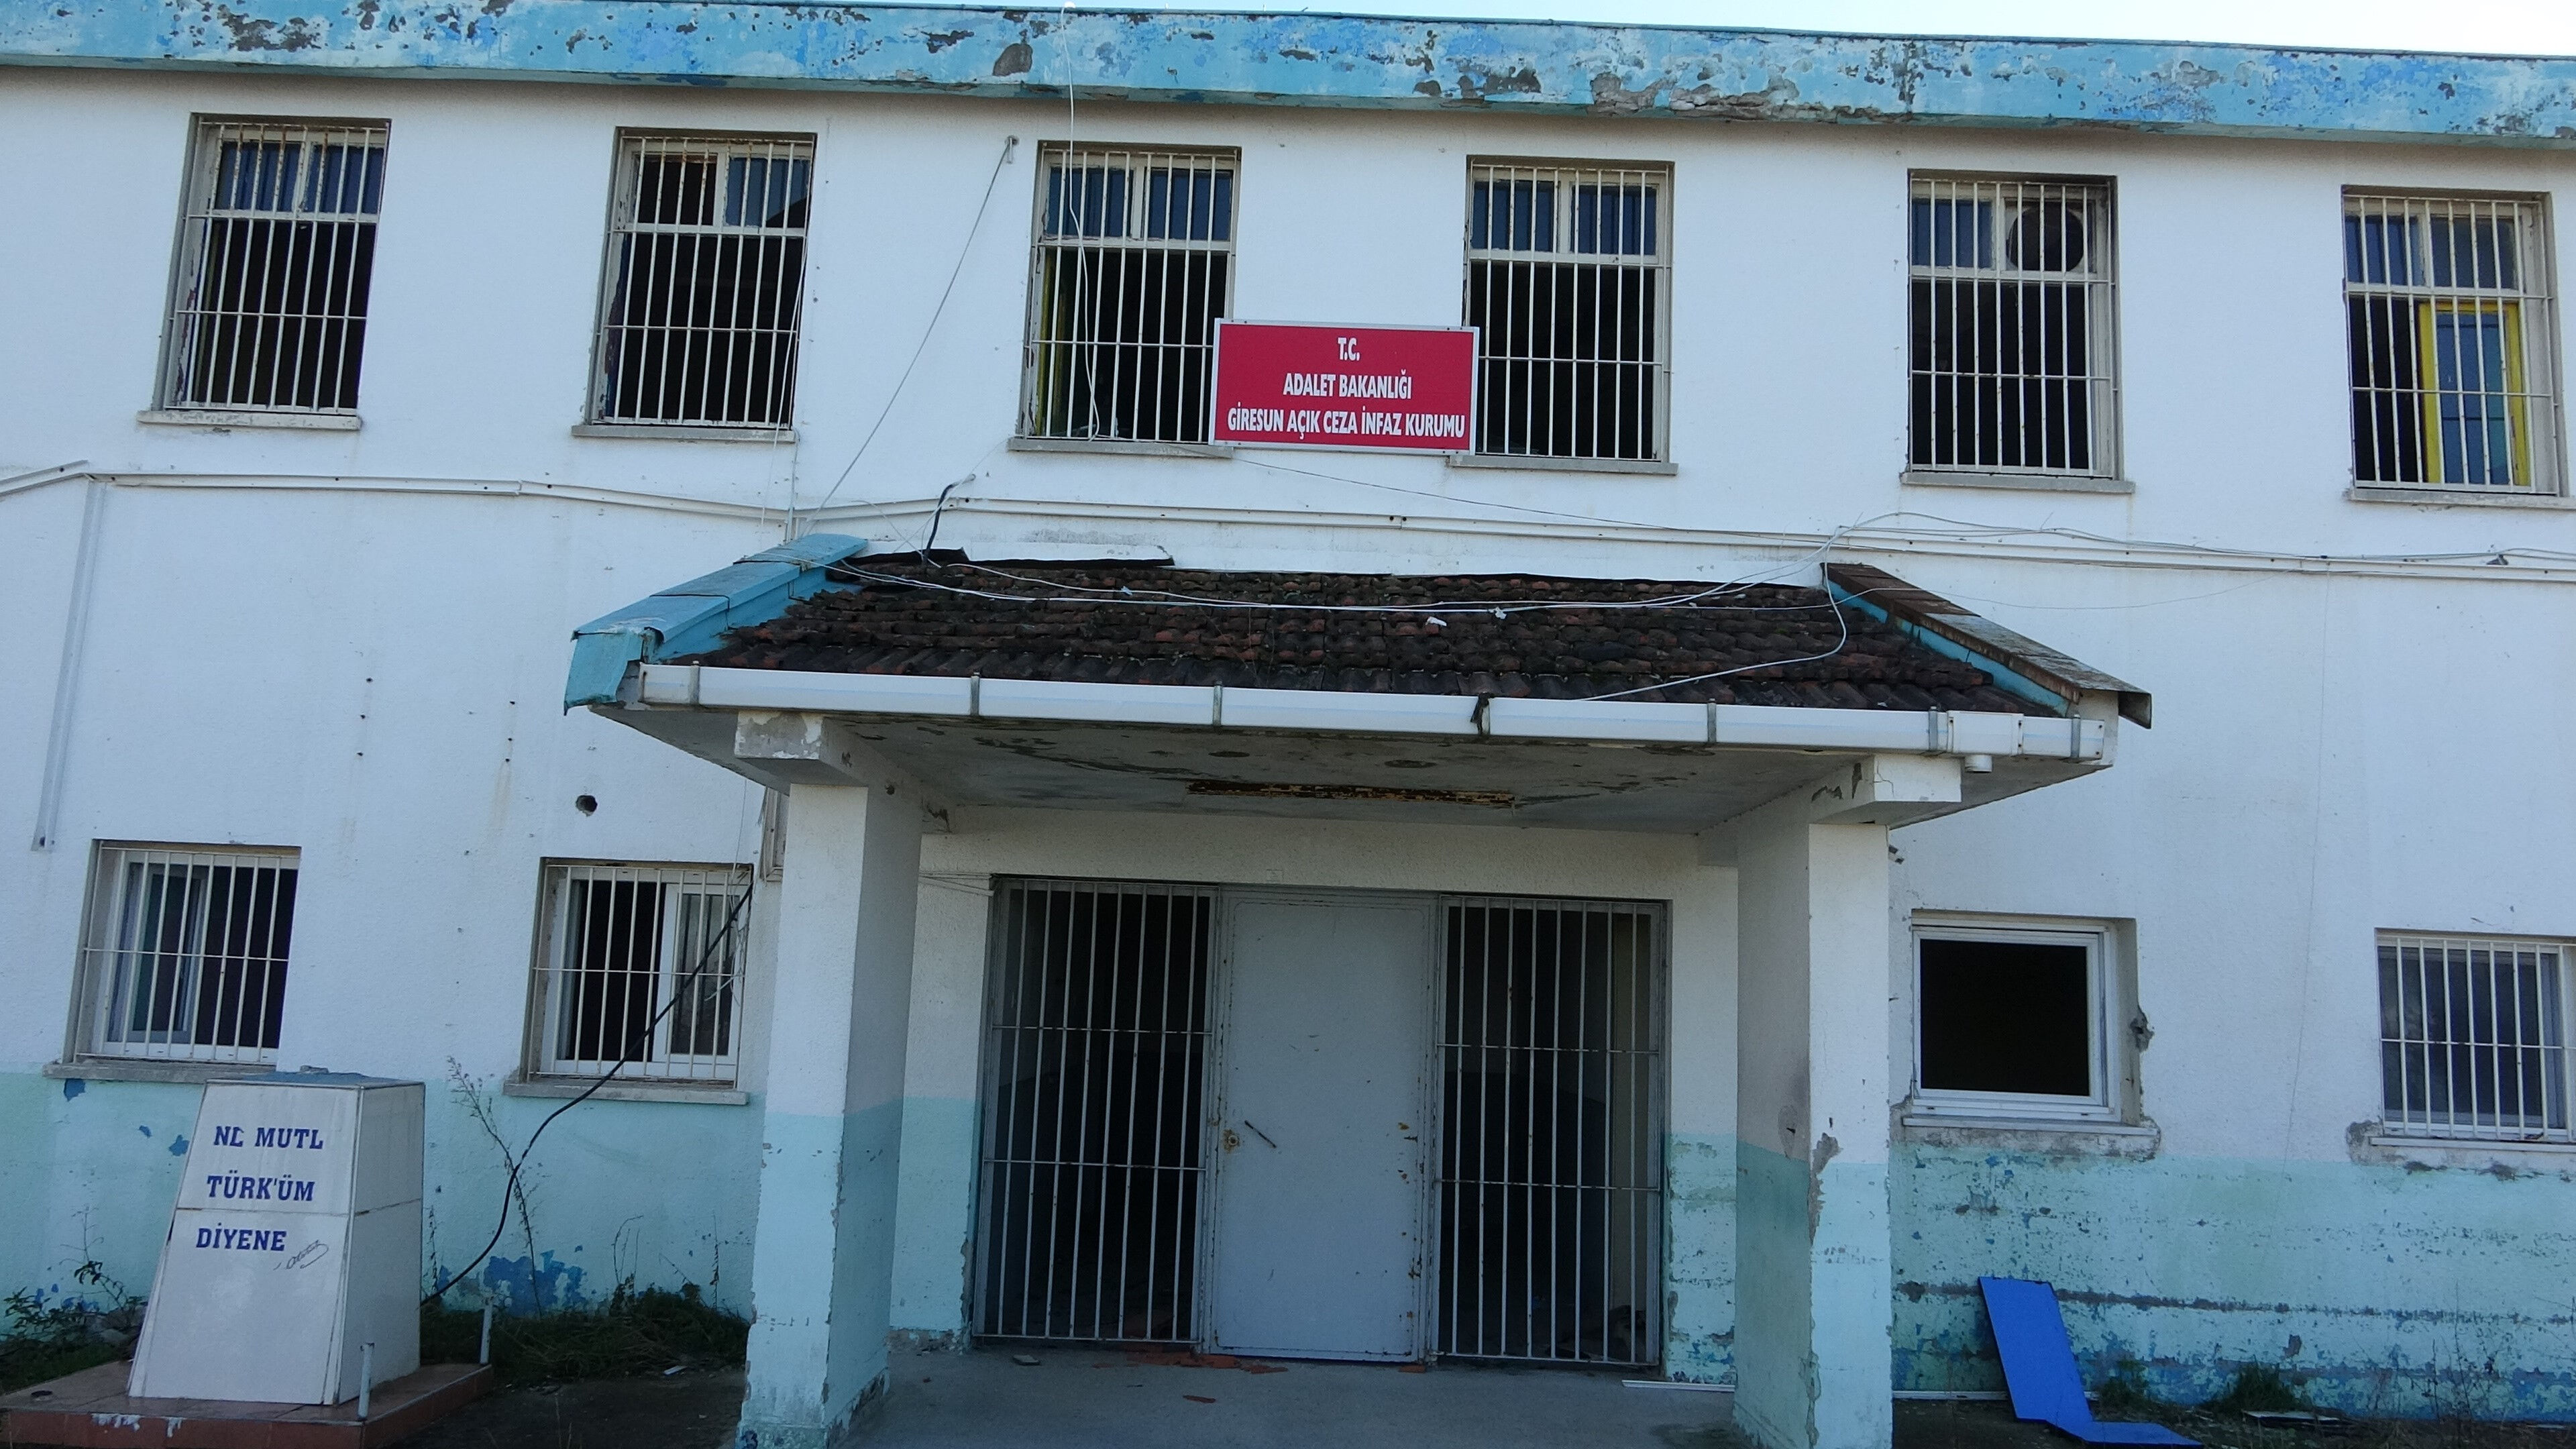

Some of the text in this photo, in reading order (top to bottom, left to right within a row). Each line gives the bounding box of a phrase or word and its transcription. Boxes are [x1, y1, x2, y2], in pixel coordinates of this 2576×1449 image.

[1338, 337, 1360, 361] T.C.
[1283, 369, 1412, 400] ADALET BAKANLIĞI
[1228, 401, 1466, 440] GİRESUN AÇIK CEZA İNFAZ KURUMU
[207, 1169, 315, 1201] TÜRK'ÜM
[196, 1222, 287, 1251] DİYENE
